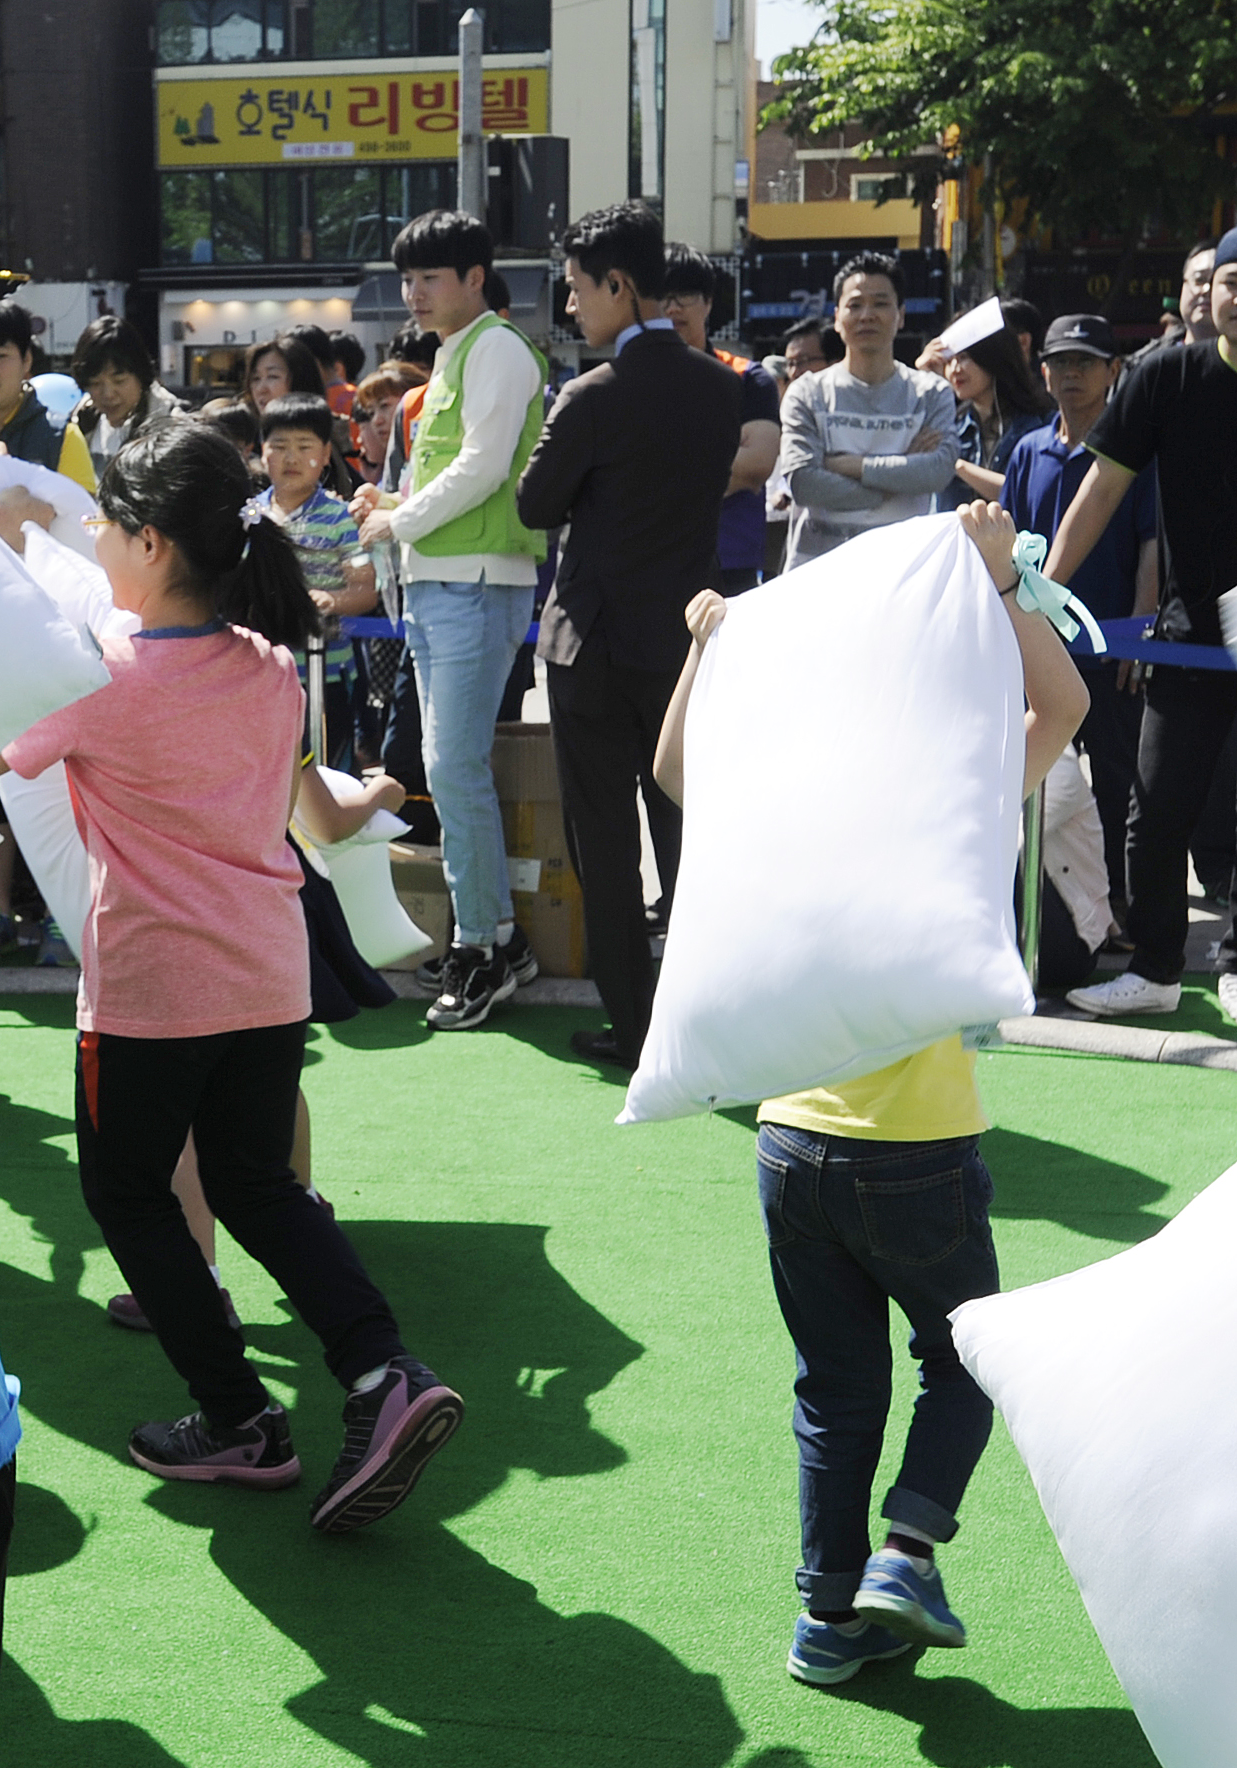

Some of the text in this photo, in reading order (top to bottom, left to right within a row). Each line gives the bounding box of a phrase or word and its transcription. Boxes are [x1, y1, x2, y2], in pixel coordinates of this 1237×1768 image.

[236, 77, 528, 141] 호텔식 리빙텔
[1086, 275, 1172, 299] Qeen
